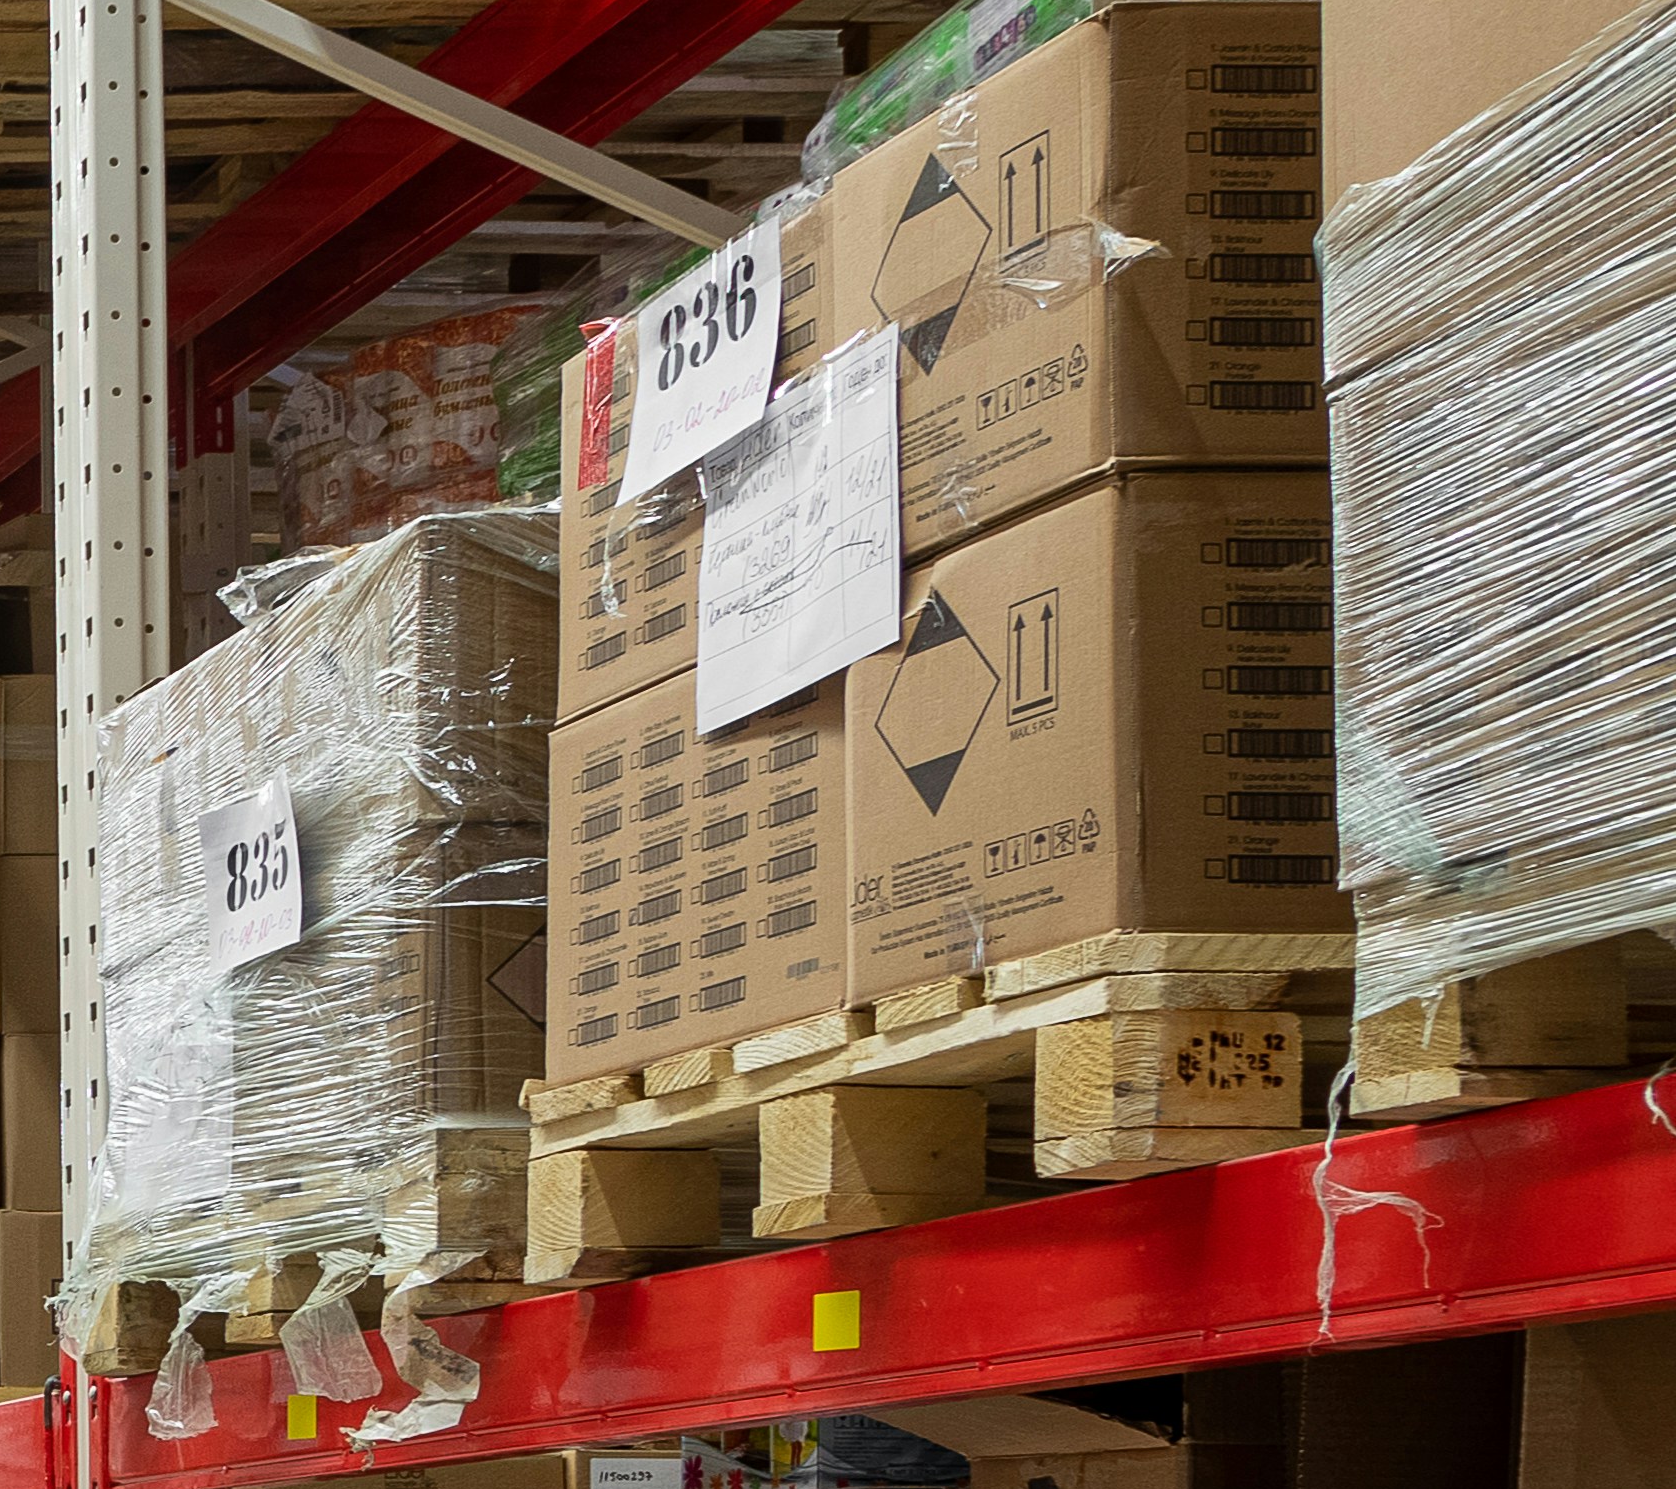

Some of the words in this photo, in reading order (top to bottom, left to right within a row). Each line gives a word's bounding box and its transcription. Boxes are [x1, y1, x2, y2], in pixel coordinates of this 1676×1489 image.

[657, 254, 756, 392] 836
[1038, 717, 1056, 731] PCS
[226, 819, 288, 911] 835
[598, 1471, 653, 1484] 11500297
